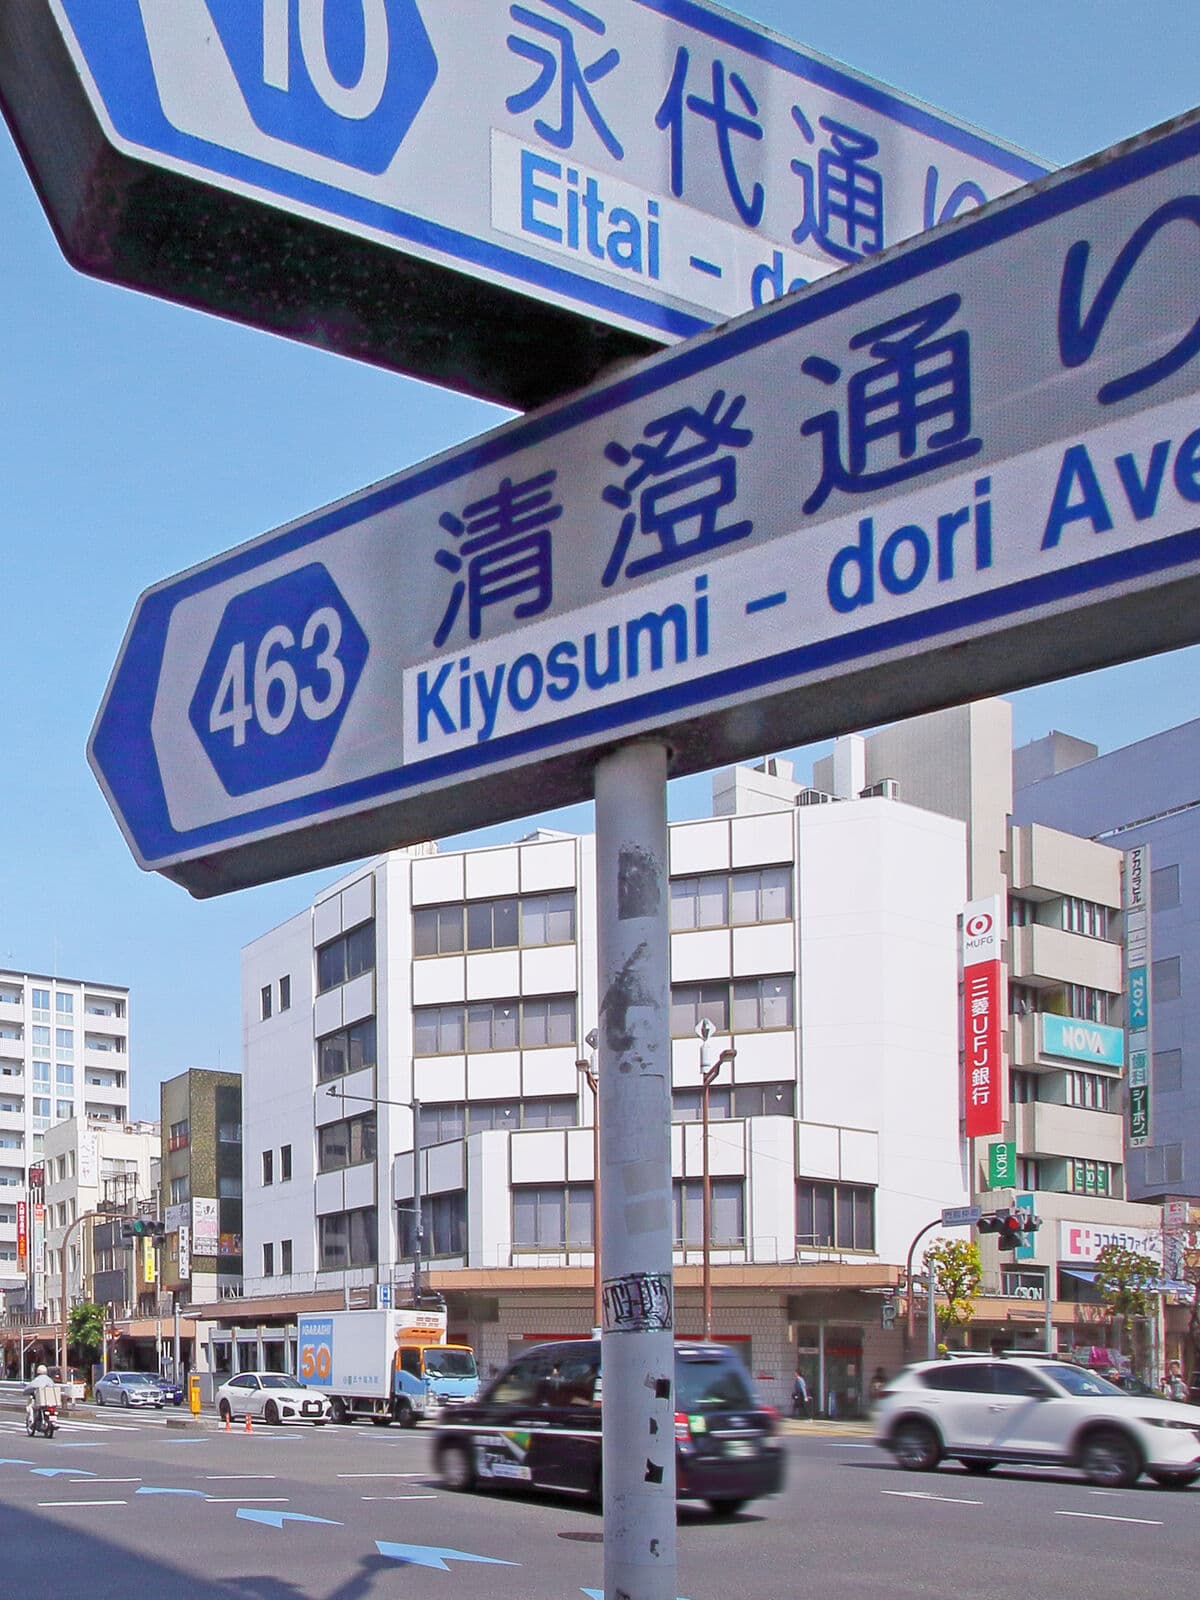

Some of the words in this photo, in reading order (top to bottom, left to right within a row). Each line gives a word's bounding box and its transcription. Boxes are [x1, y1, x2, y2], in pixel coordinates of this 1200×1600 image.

[262, 0, 388, 119] 10
[519, 147, 660, 281] Eitai
[433, 195, 1200, 648] 清澄通り
[416, 575, 709, 744] Kiyosumi
[826, 475, 993, 614] dori
[208, 606, 346, 747] 463
[966, 935, 994, 950] MUFG
[1132, 975, 1144, 1017] NOVA
[971, 976, 990, 1106] 三菱UFJ銀行
[1062, 1024, 1105, 1055] NOVA
[301, 1343, 332, 1379] 50
